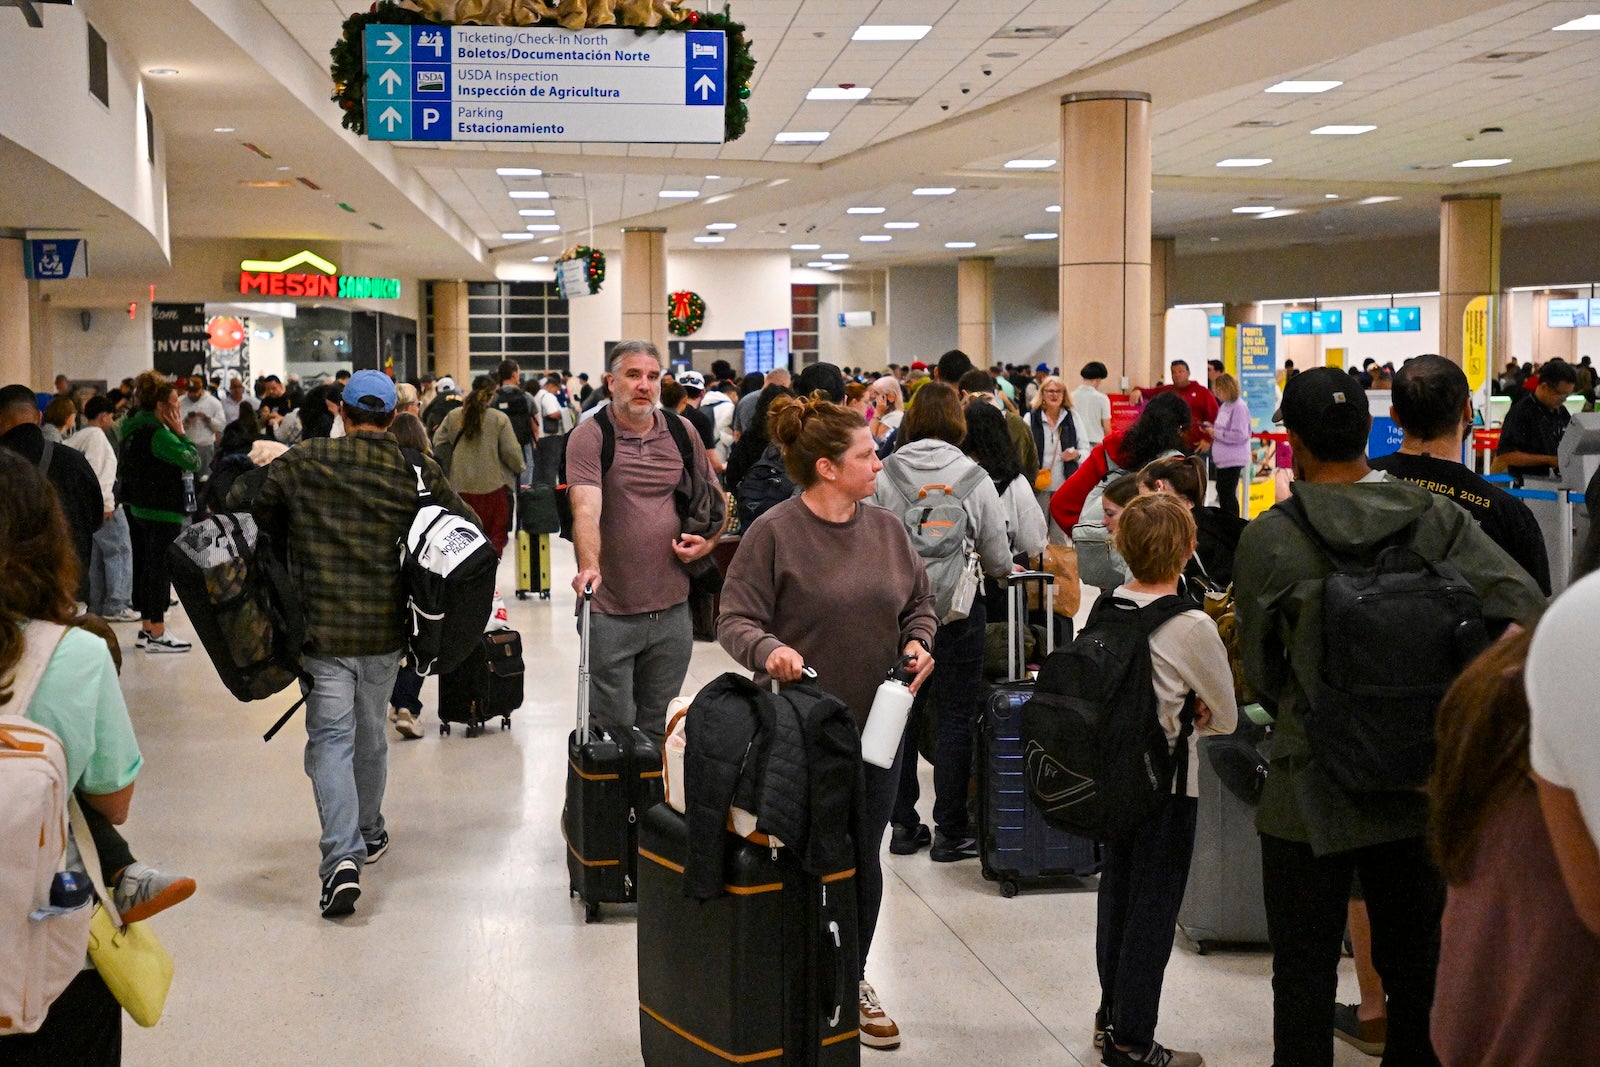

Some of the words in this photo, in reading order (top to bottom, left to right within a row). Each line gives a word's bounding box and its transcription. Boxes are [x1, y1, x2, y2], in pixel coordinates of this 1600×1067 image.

[458, 31, 570, 46] Ticketing/Check-In
[574, 34, 608, 46] North
[458, 47, 611, 61] Boletos/Documentación
[615, 50, 650, 62] Norte
[418, 72, 443, 81] USDA
[458, 69, 492, 80] USDA
[496, 70, 559, 83] Inspection
[458, 85, 525, 98] Inspección
[530, 86, 545, 97] de
[549, 86, 620, 100] Agricultura
[458, 107, 503, 120] Parking
[458, 123, 565, 135] Estacionamiento
[1460, 490, 1491, 508] 2023
[443, 530, 456, 542] THE
[441, 534, 464, 556] NORTH
[452, 540, 469, 556] FACE
